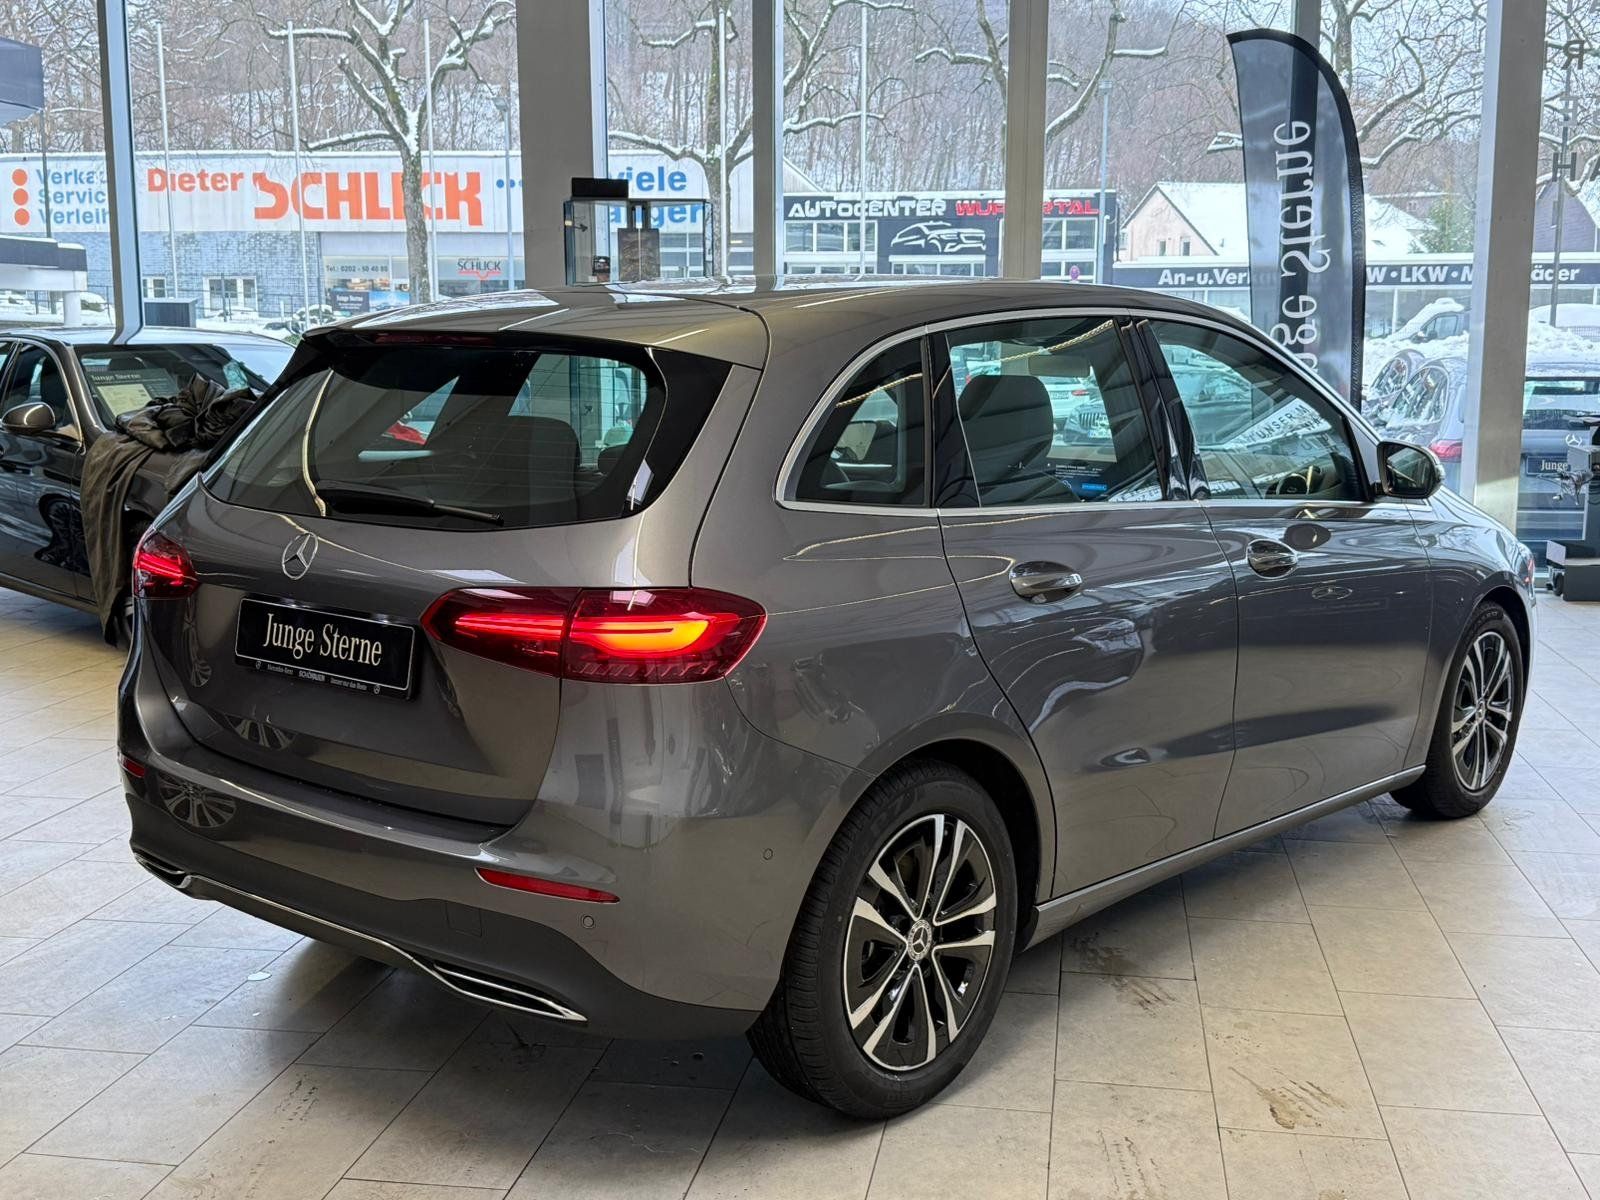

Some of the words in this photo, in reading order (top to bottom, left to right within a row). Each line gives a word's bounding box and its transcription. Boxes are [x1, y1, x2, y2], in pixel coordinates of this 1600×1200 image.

[147, 168, 244, 192] Dieter
[787, 199, 948, 218] AUTOCENTER
[1401, 265, 1448, 283] LKW
[1540, 459, 1569, 472] Junge
[262, 612, 315, 660] Junge
[319, 623, 383, 667] Sterne
